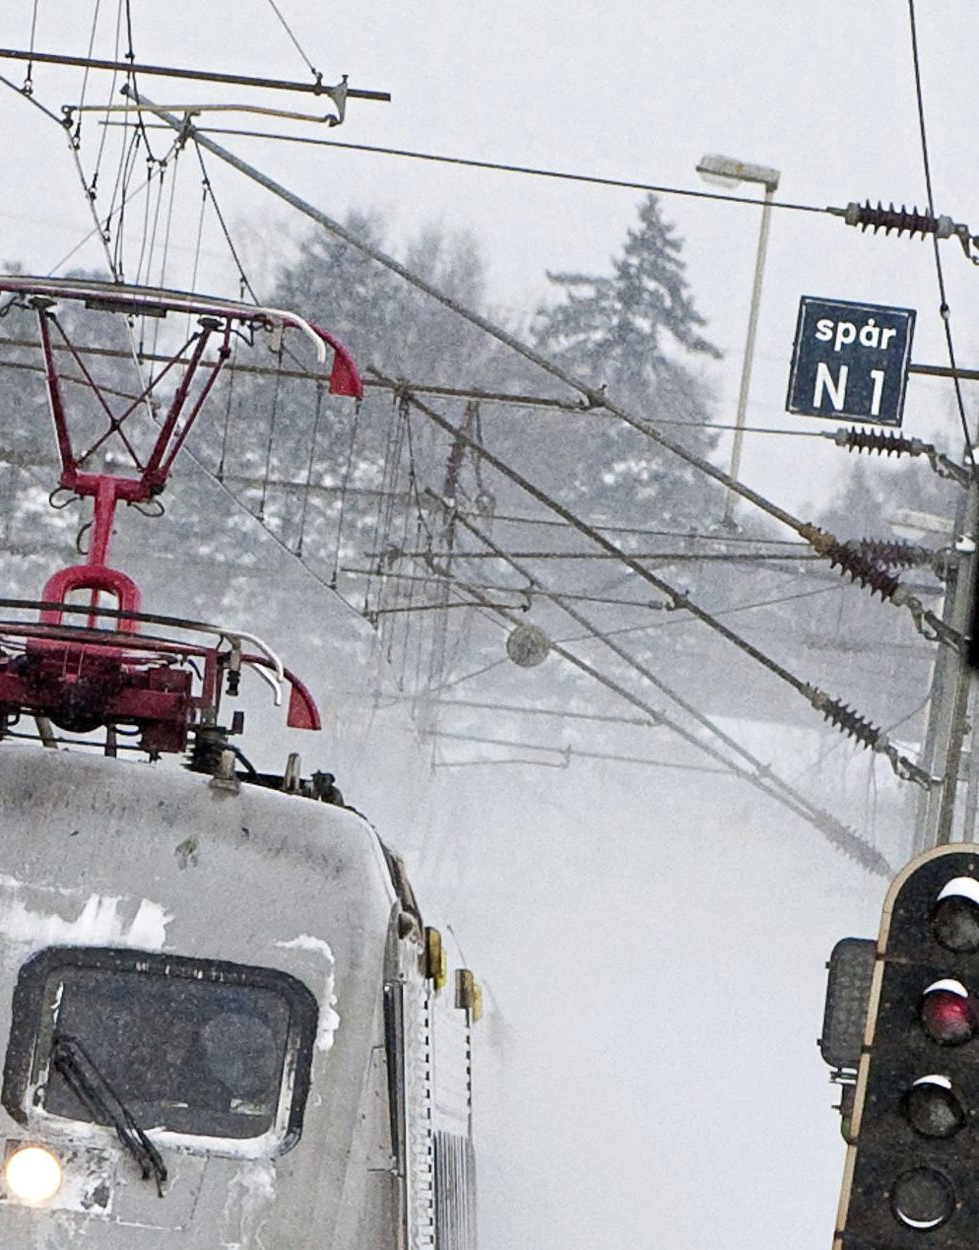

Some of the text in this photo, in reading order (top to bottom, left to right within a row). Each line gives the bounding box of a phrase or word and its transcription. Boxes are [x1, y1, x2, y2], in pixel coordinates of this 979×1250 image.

[815, 318, 897, 351] spår
[813, 362, 885, 416] N 1
